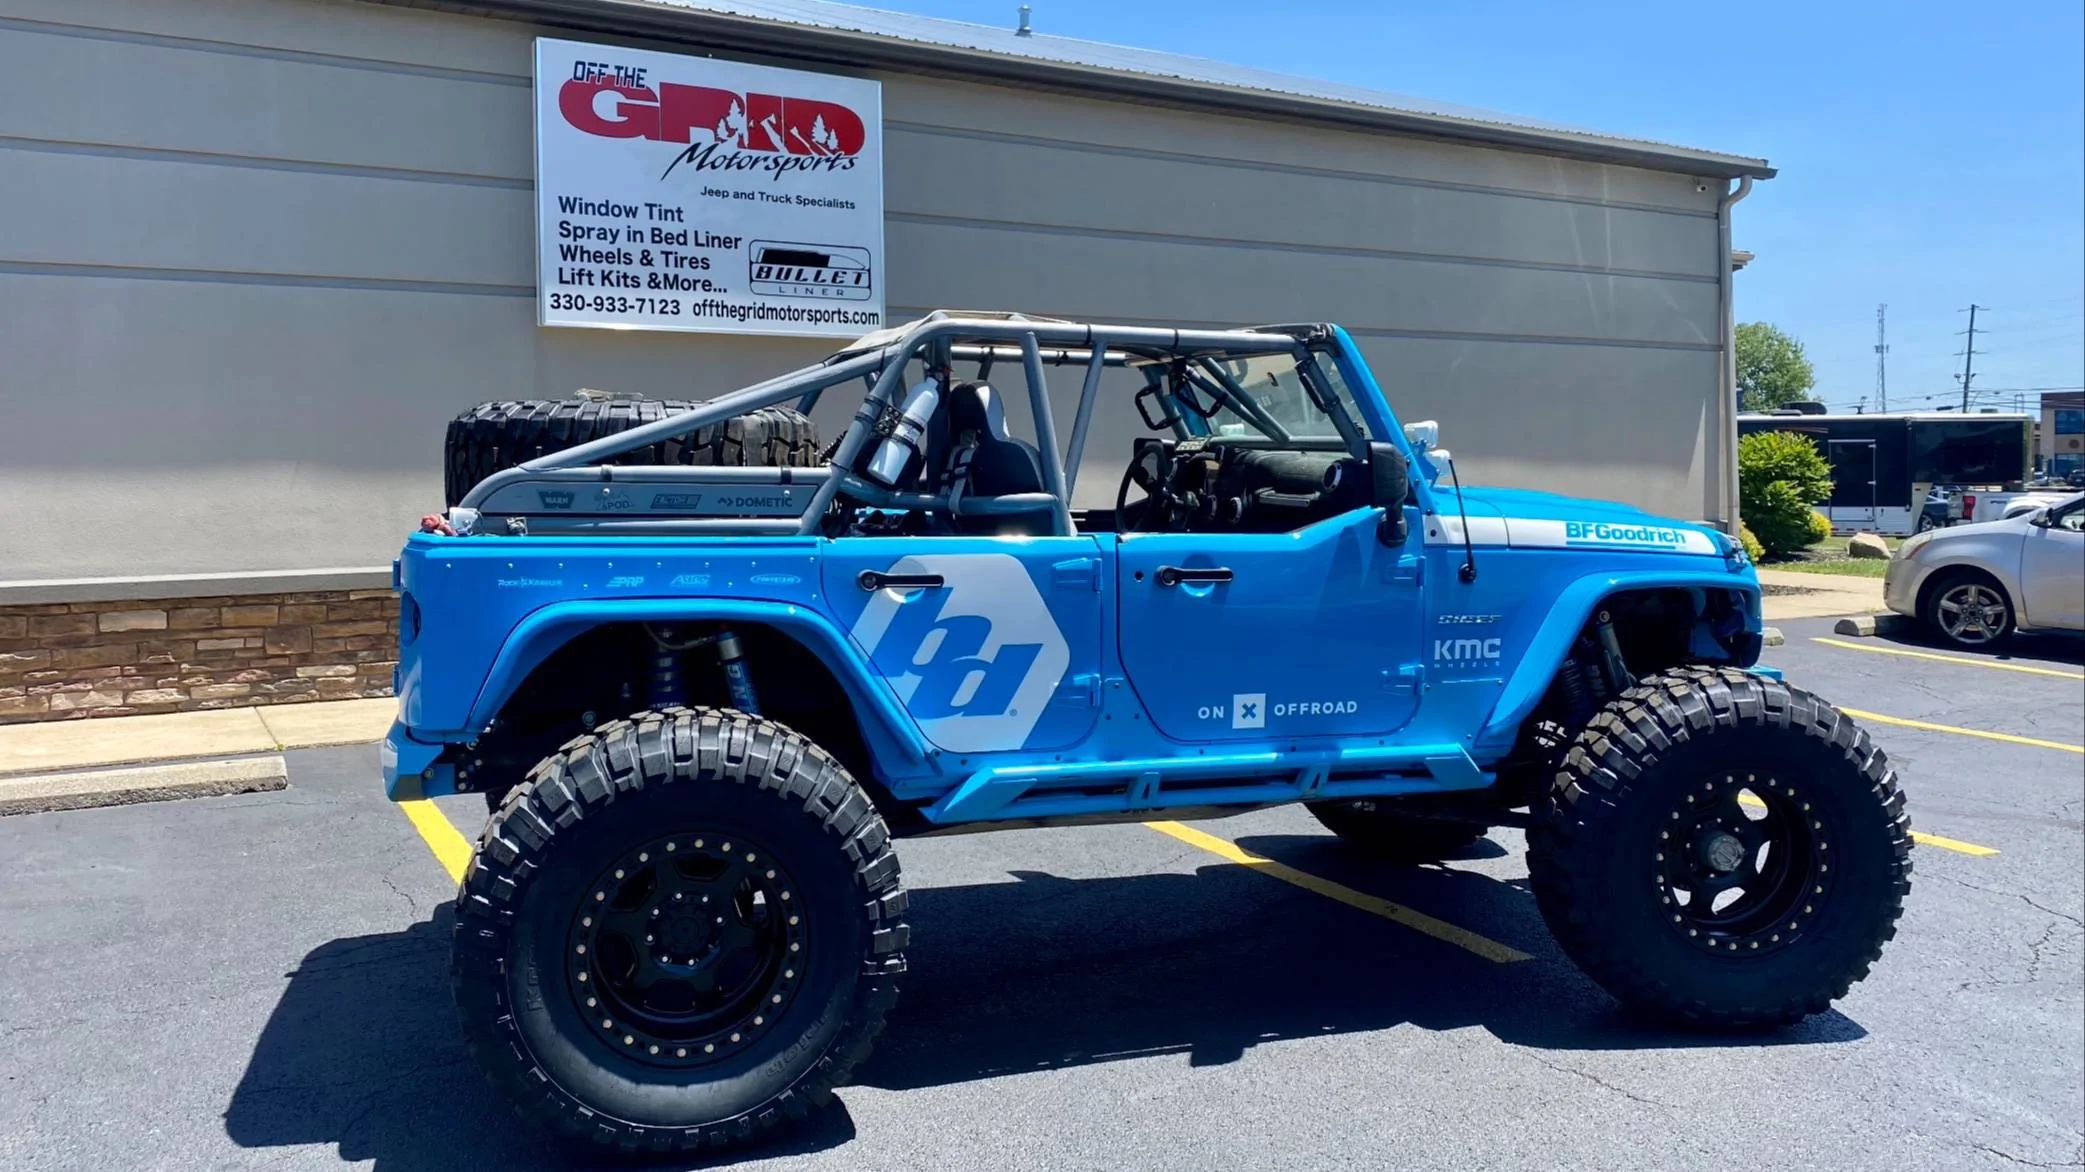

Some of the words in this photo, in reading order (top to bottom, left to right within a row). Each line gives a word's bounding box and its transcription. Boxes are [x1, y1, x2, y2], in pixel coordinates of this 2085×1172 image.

[573, 60, 609, 83] OFF
[614, 65, 647, 88] THE
[559, 75, 865, 156] GRID
[661, 142, 860, 181] Motorsports
[558, 195, 639, 219] Window
[644, 202, 684, 223] Tint
[700, 186, 730, 199] Jeep
[733, 190, 755, 201] and
[758, 192, 792, 204] Truck
[795, 195, 856, 210] Specialists
[558, 220, 620, 244] Spray
[626, 225, 644, 243] in
[650, 227, 688, 246] Bed
[694, 230, 742, 249] Liner
[559, 244, 633, 266] Wheels
[639, 249, 654, 267] &
[660, 250, 711, 270] Tires
[558, 267, 595, 286] Lift
[600, 269, 641, 289] Kits
[647, 272, 728, 293] &More...
[755, 265, 867, 286] BULLET
[550, 293, 681, 315] 330-933-7123
[778, 286, 844, 297] LINER
[692, 299, 880, 325] offthegridmotorsports.com
[735, 496, 793, 508] DOMETIC
[1565, 522, 1686, 544] BFGoodrich
[1198, 706, 1225, 719] ON
[1273, 701, 1358, 716] OFFROAD
